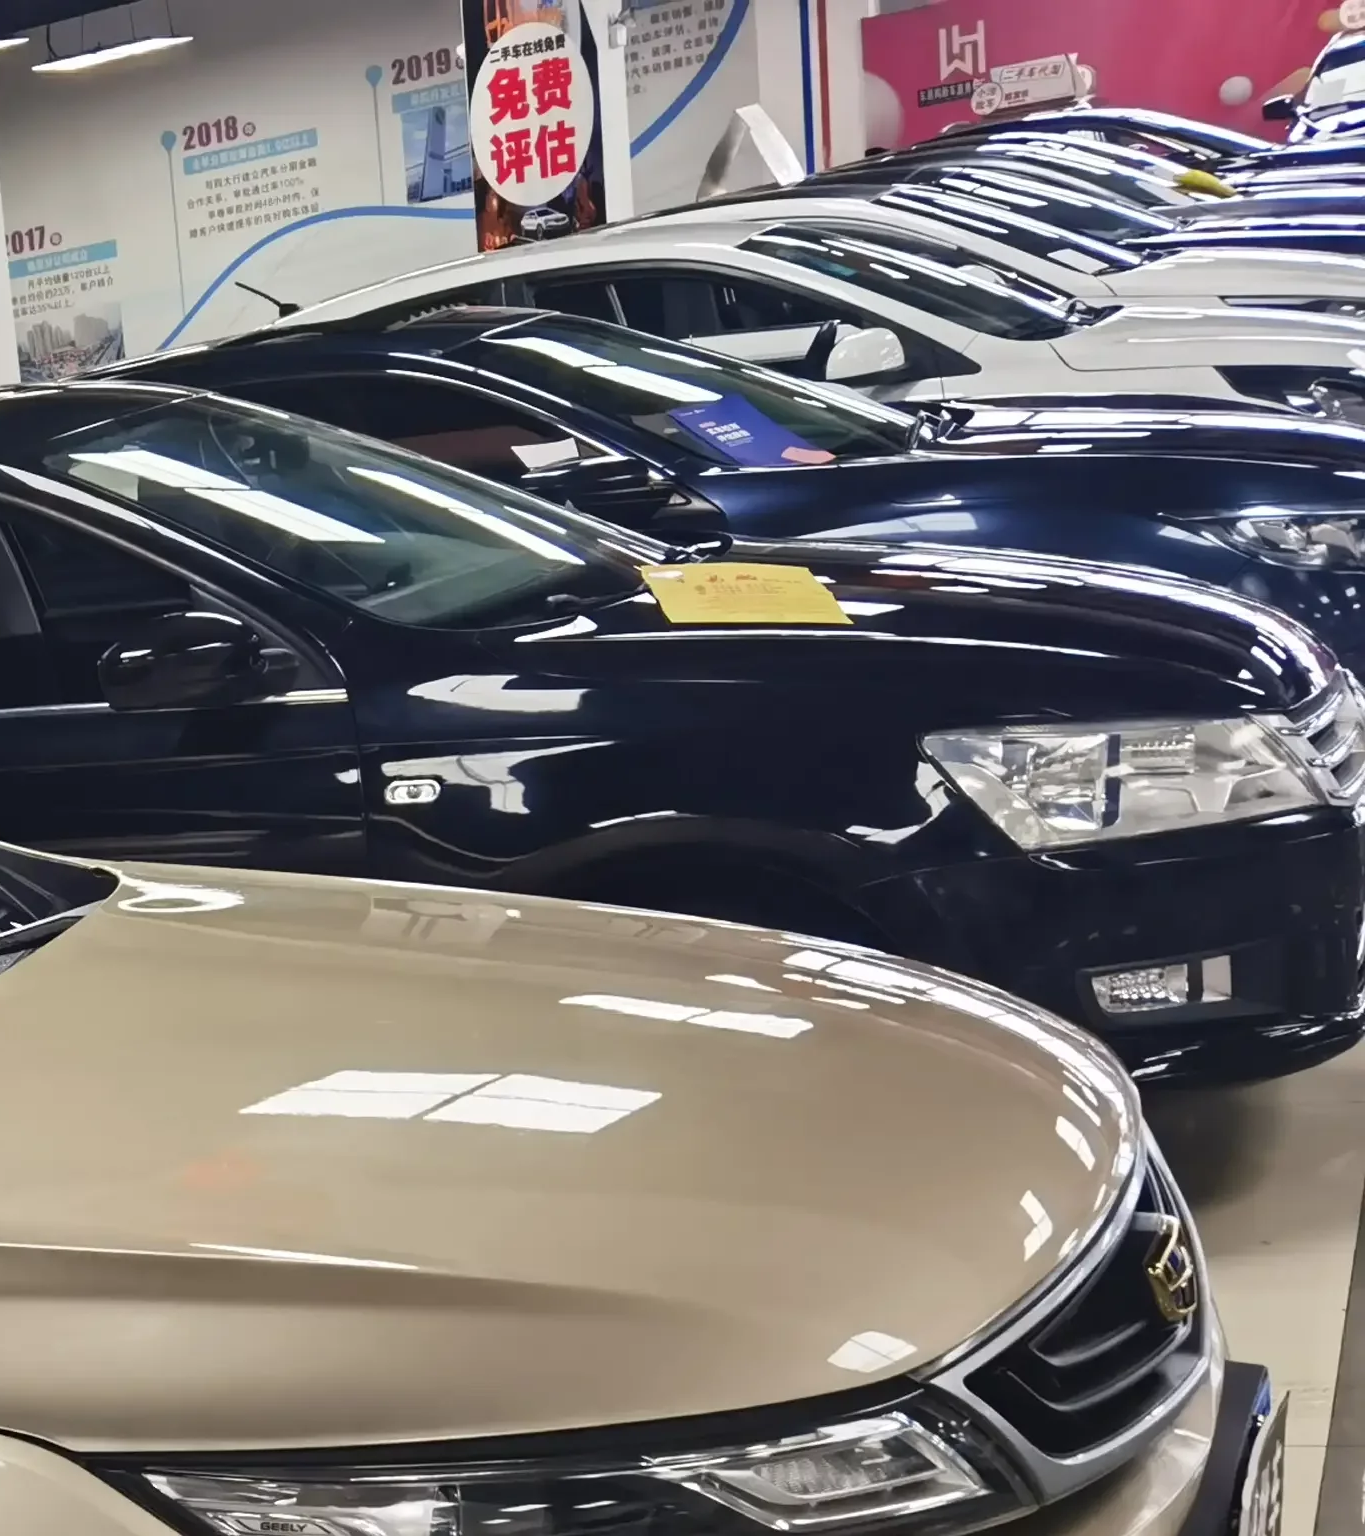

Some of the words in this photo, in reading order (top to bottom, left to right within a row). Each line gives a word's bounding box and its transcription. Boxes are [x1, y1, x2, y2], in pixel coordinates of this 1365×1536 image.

[391, 48, 451, 85] 2019
[489, 34, 566, 63] 二手车在线免费
[487, 57, 573, 125] 免费
[182, 115, 239, 151] 2018
[489, 120, 577, 185] 评估
[260, 1521, 307, 1532] GEELY
